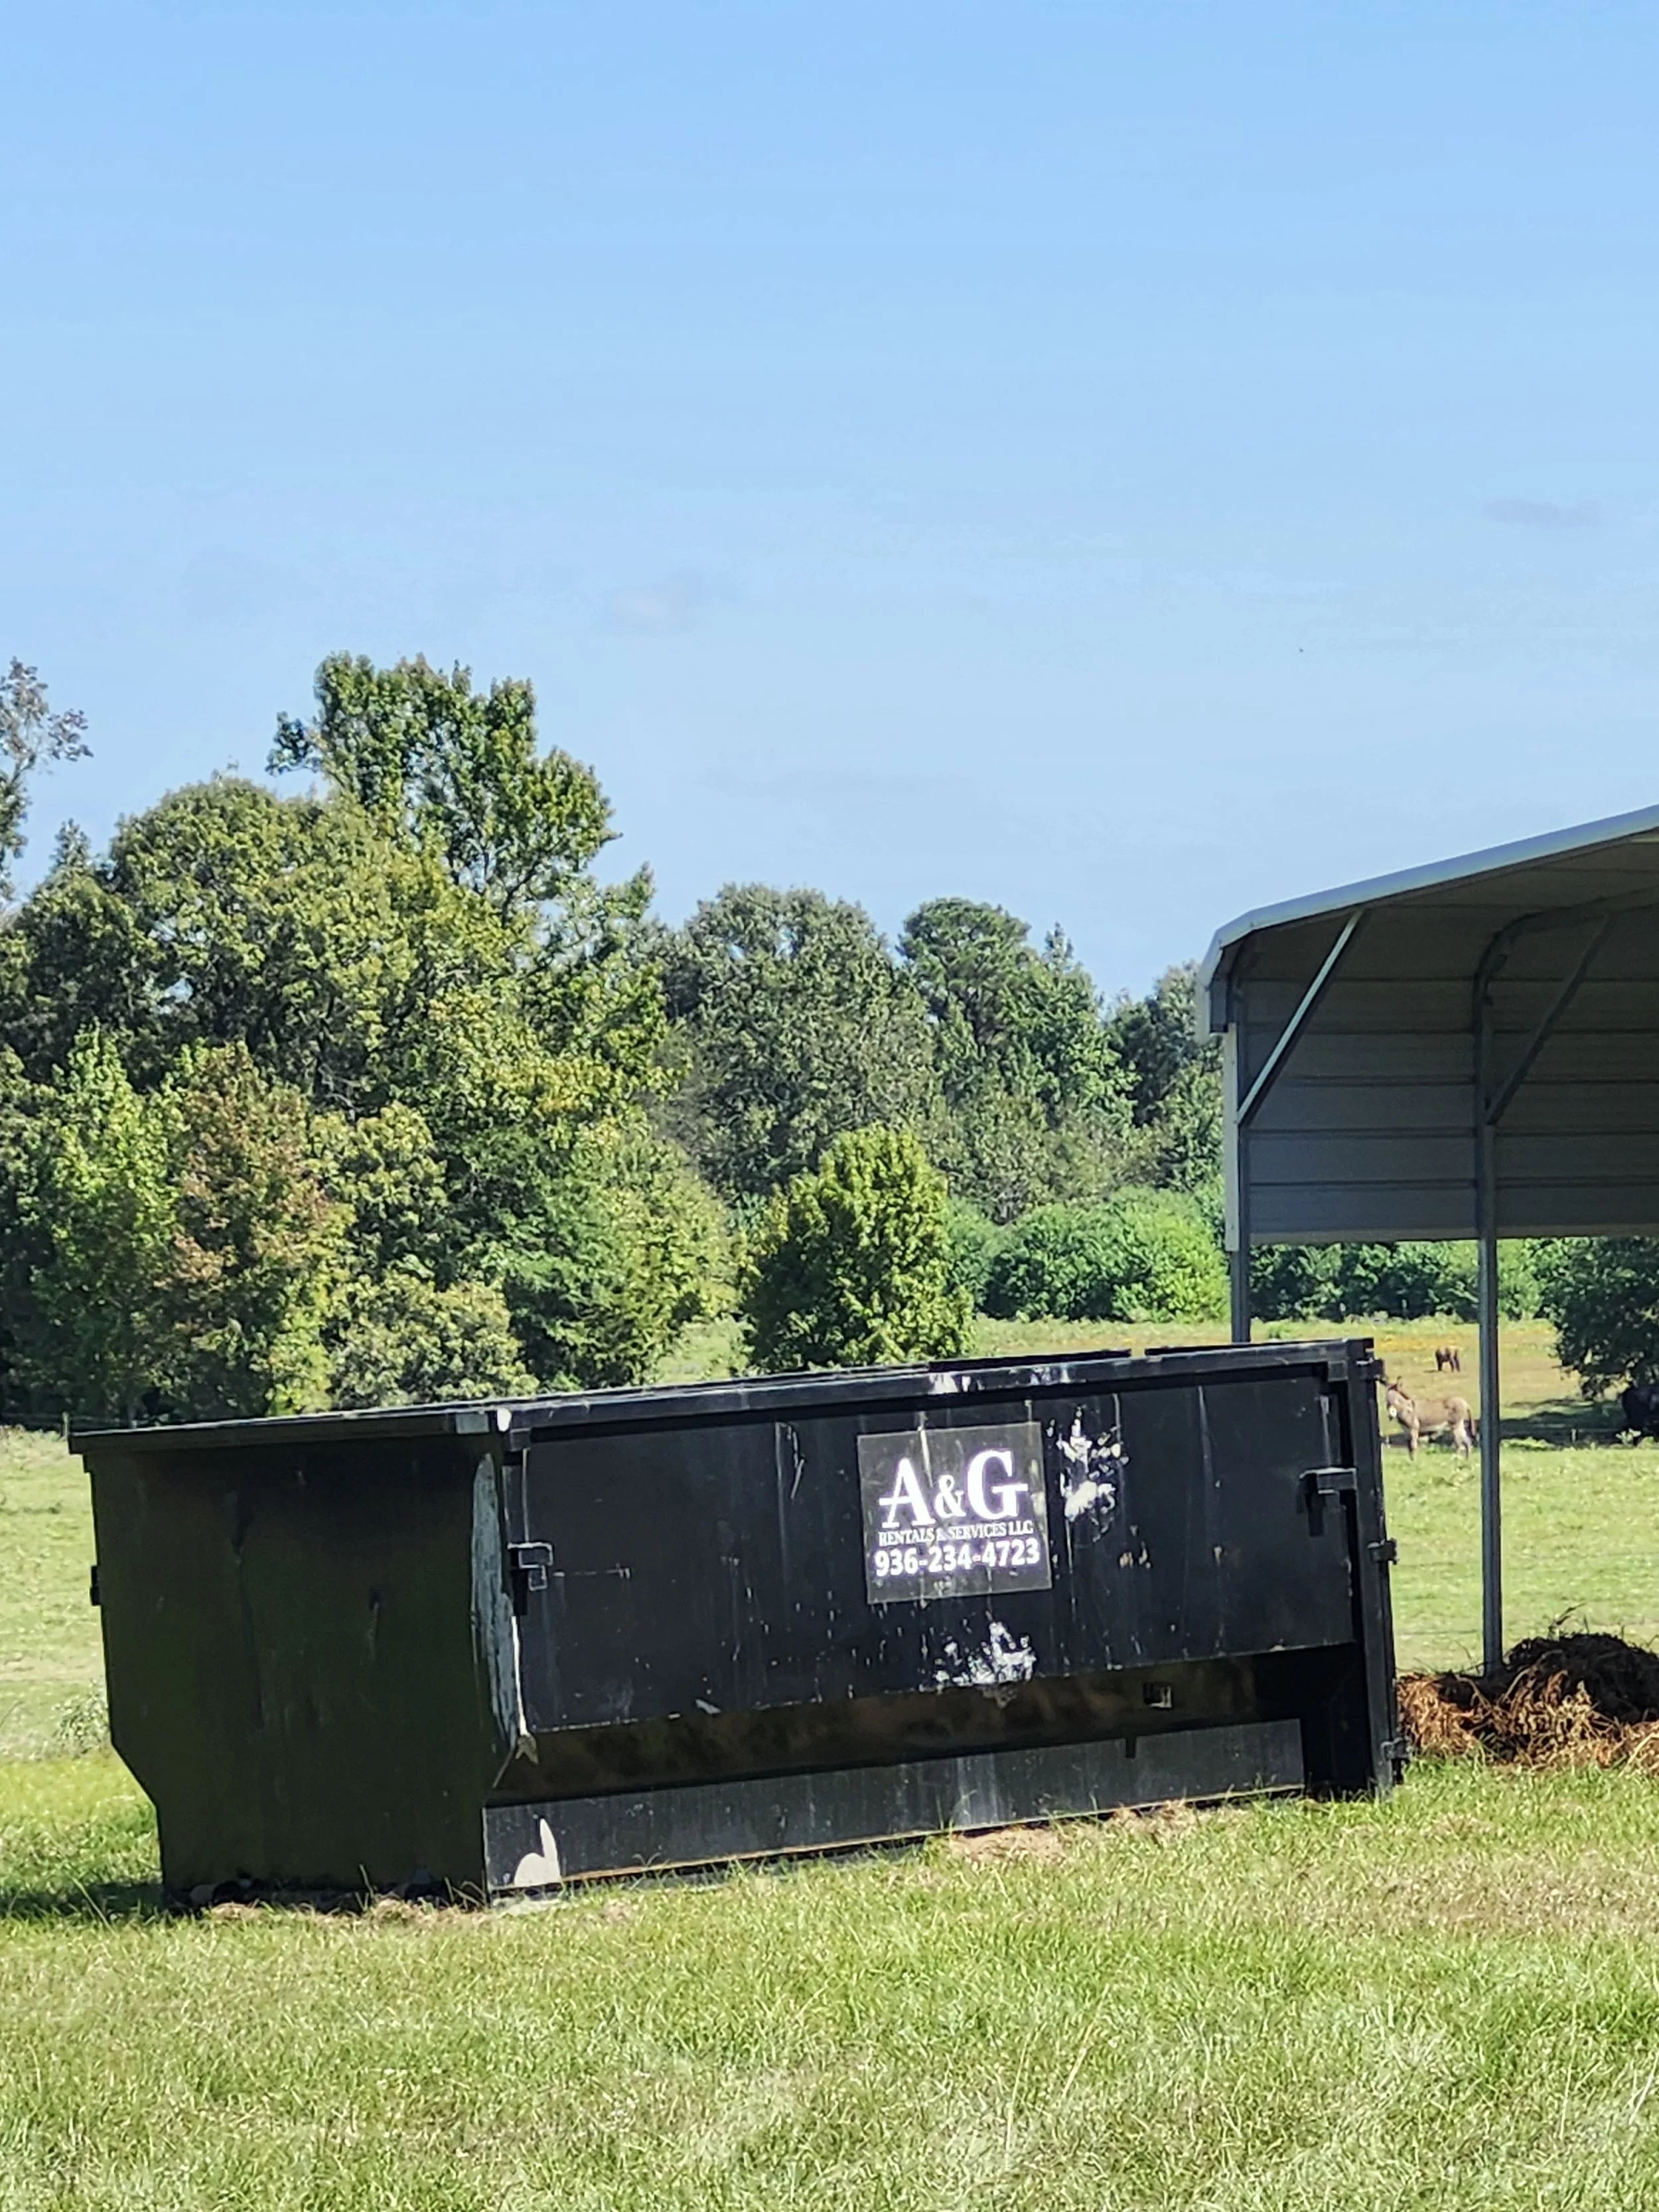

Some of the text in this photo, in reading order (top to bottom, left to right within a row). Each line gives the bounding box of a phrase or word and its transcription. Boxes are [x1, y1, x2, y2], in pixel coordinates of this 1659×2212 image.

[879, 1449, 1028, 1528] A&G
[878, 1528, 934, 1546] RENTALS
[950, 1522, 1007, 1540] SERVICES
[1009, 1520, 1034, 1534] LLC
[874, 1538, 1040, 1577] 936-234-4723
